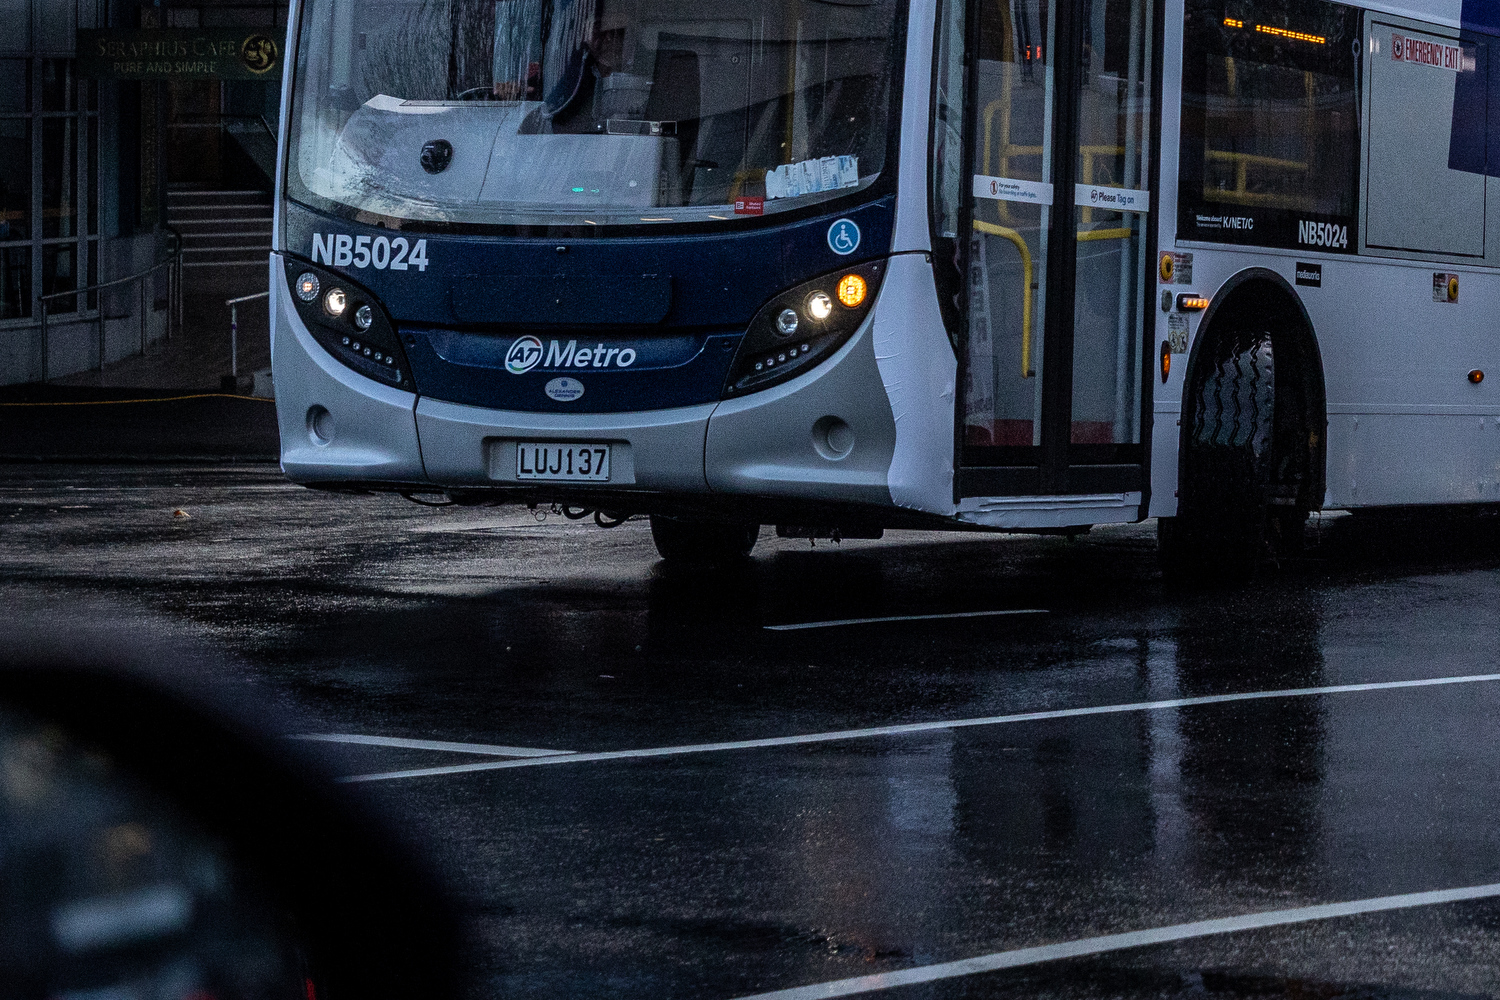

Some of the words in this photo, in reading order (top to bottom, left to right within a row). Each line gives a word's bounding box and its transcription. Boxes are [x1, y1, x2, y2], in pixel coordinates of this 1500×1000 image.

[113, 61, 143, 73] PURE
[146, 61, 173, 73] AND
[174, 61, 218, 73] SIMPLE
[1405, 38, 1443, 66] EMERGENCY
[1444, 46, 1459, 70] EXIT
[1099, 192, 1116, 203] Please
[1116, 194, 1126, 206] Tag
[1298, 219, 1348, 249] NB5024
[311, 232, 429, 272] NB5024
[543, 339, 637, 368] Metro
[519, 447, 606, 475] LUJ137
